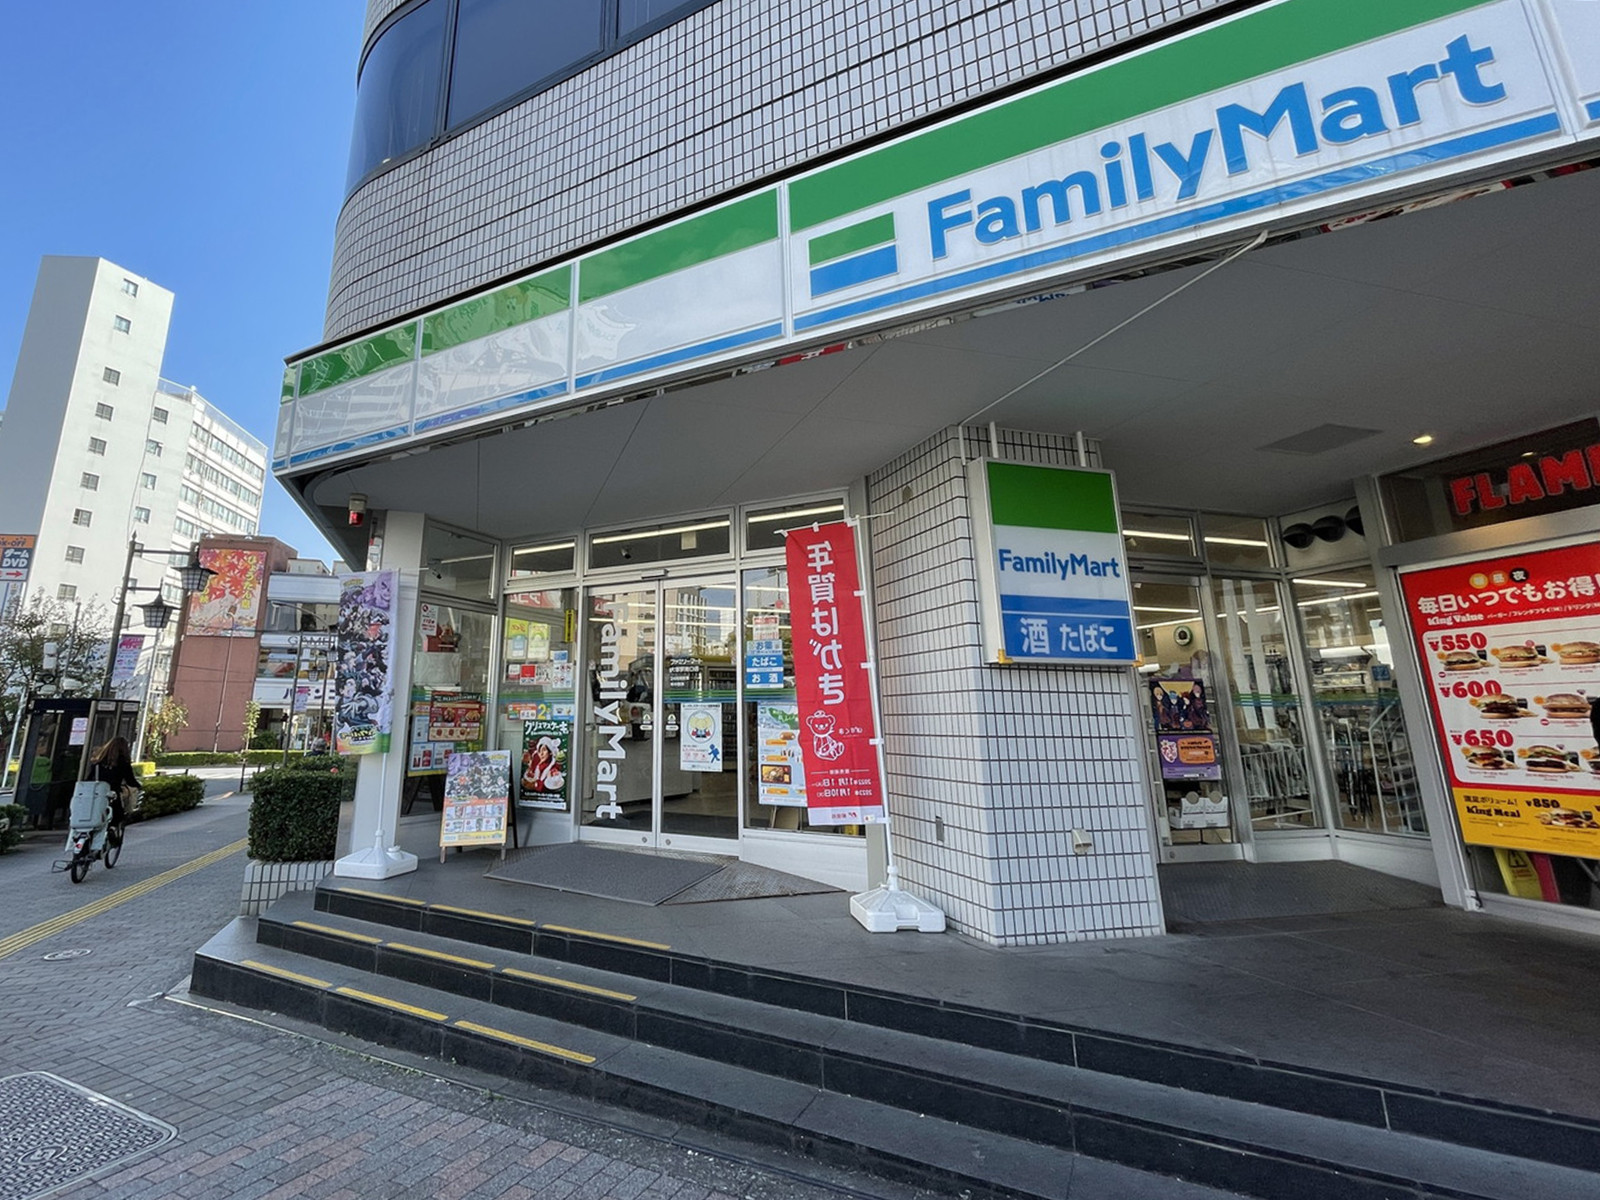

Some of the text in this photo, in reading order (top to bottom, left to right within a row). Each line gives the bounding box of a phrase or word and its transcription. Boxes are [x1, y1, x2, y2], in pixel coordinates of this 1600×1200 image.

[927, 33, 1508, 262] FamilyMart
[2, 558, 28, 568] DVD
[998, 548, 1121, 581] FamilyMart
[1512, 570, 1527, 581] 夜
[1427, 612, 1485, 626] King Value
[1020, 617, 1118, 655] 酒 たばこ
[1428, 631, 1488, 652] ¥550
[751, 657, 778, 667] たばこ
[1440, 679, 1502, 699] ¥600
[593, 603, 629, 819] FamilyMart
[1451, 729, 1514, 747] ¥650
[1525, 797, 1561, 809] ¥850
